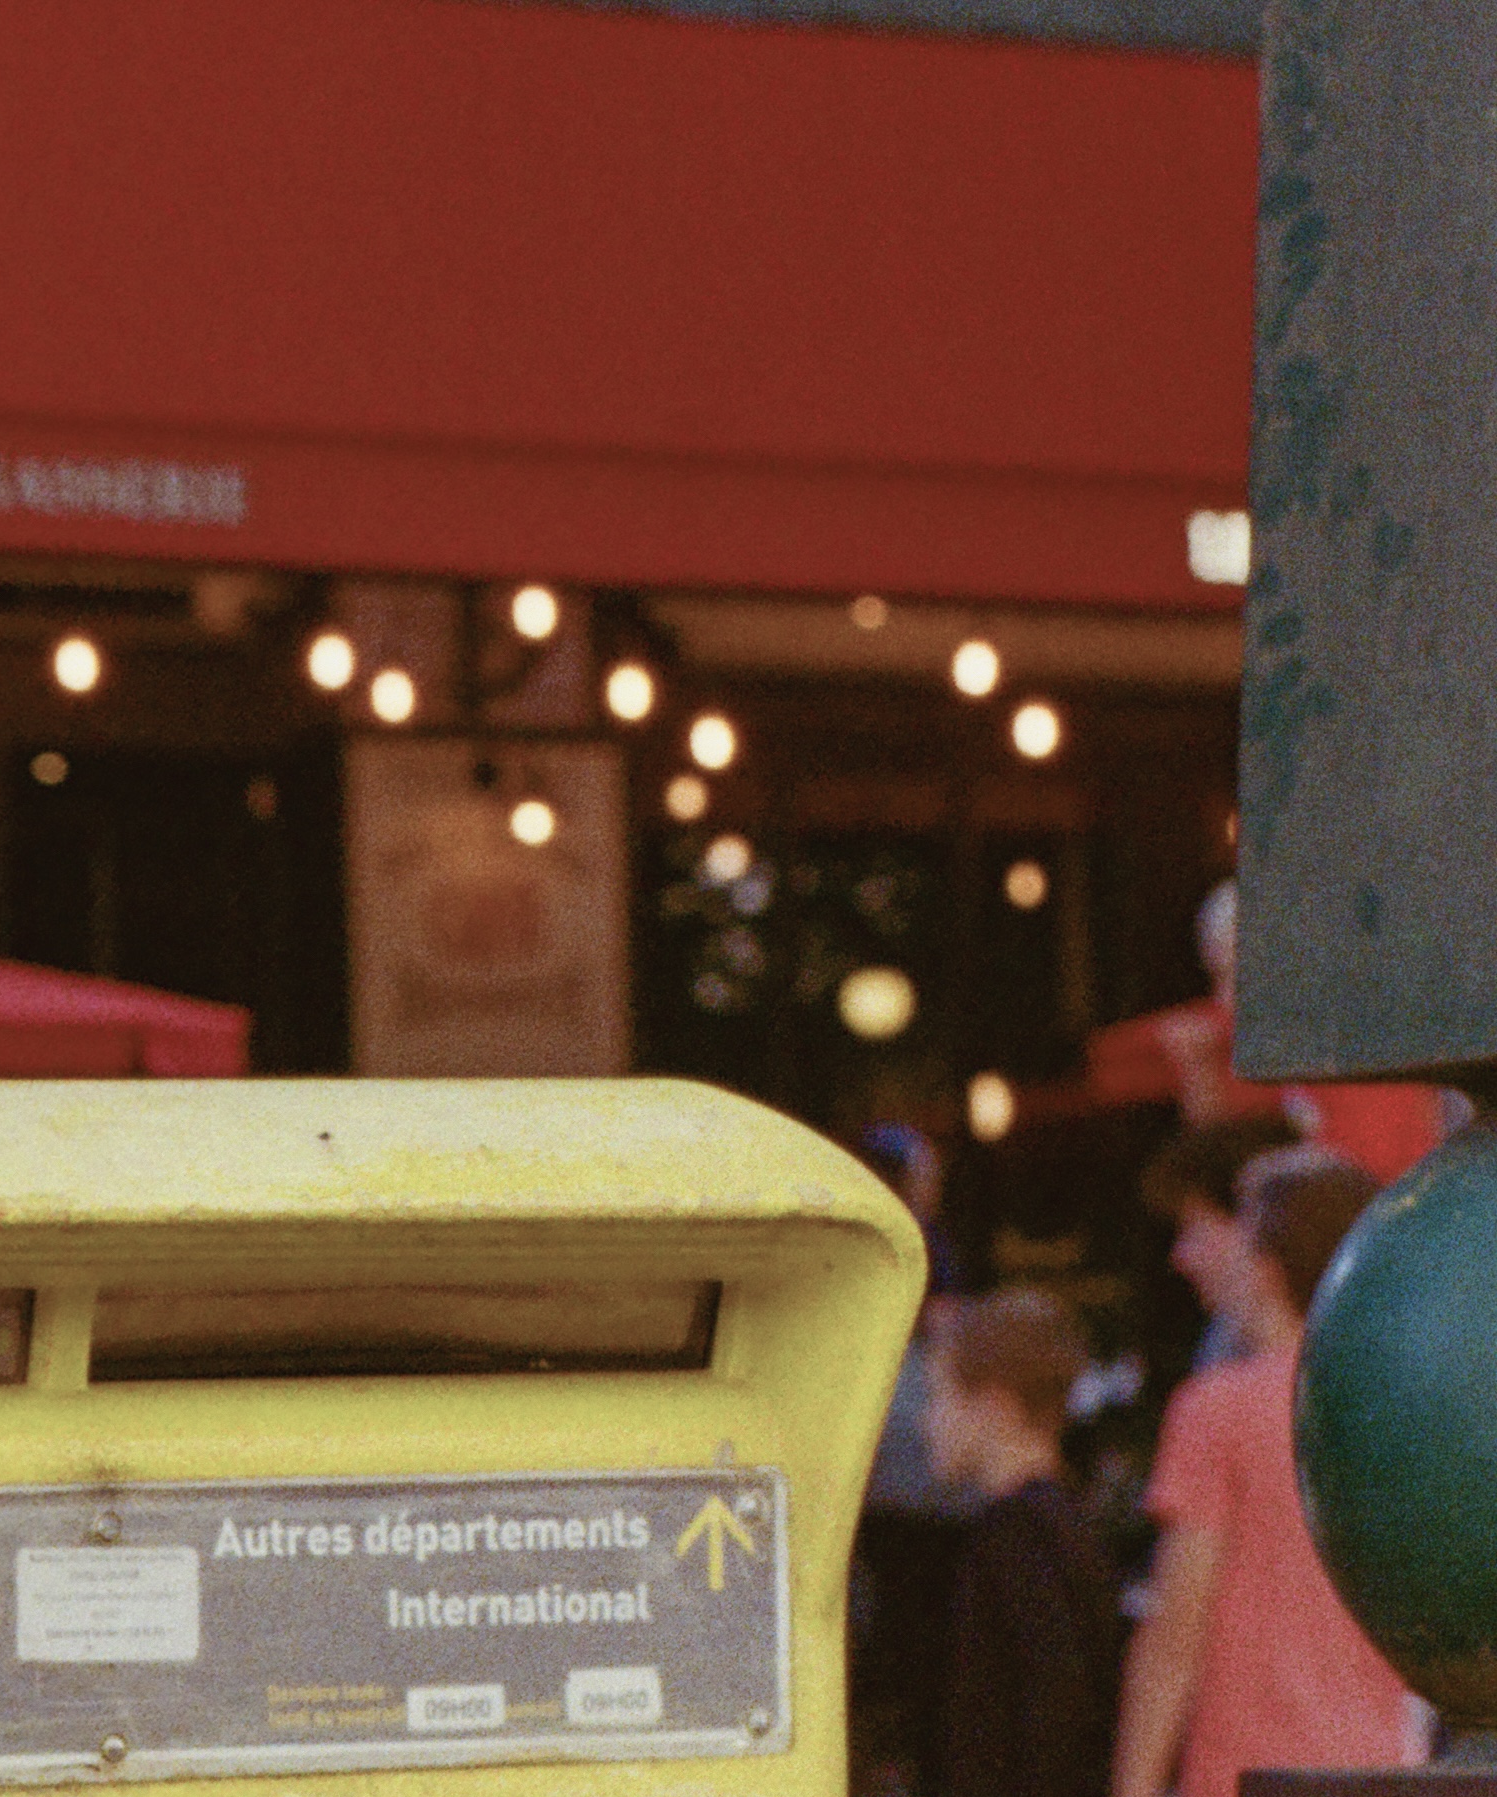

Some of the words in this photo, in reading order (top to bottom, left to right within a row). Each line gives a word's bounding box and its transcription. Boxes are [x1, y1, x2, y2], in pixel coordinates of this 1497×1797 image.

[213, 1517, 353, 1558] Autres
[365, 1509, 650, 1562] départements
[387, 1582, 651, 1629] International
[424, 1696, 492, 1721] 09H00
[581, 1688, 649, 1714] 09H00
